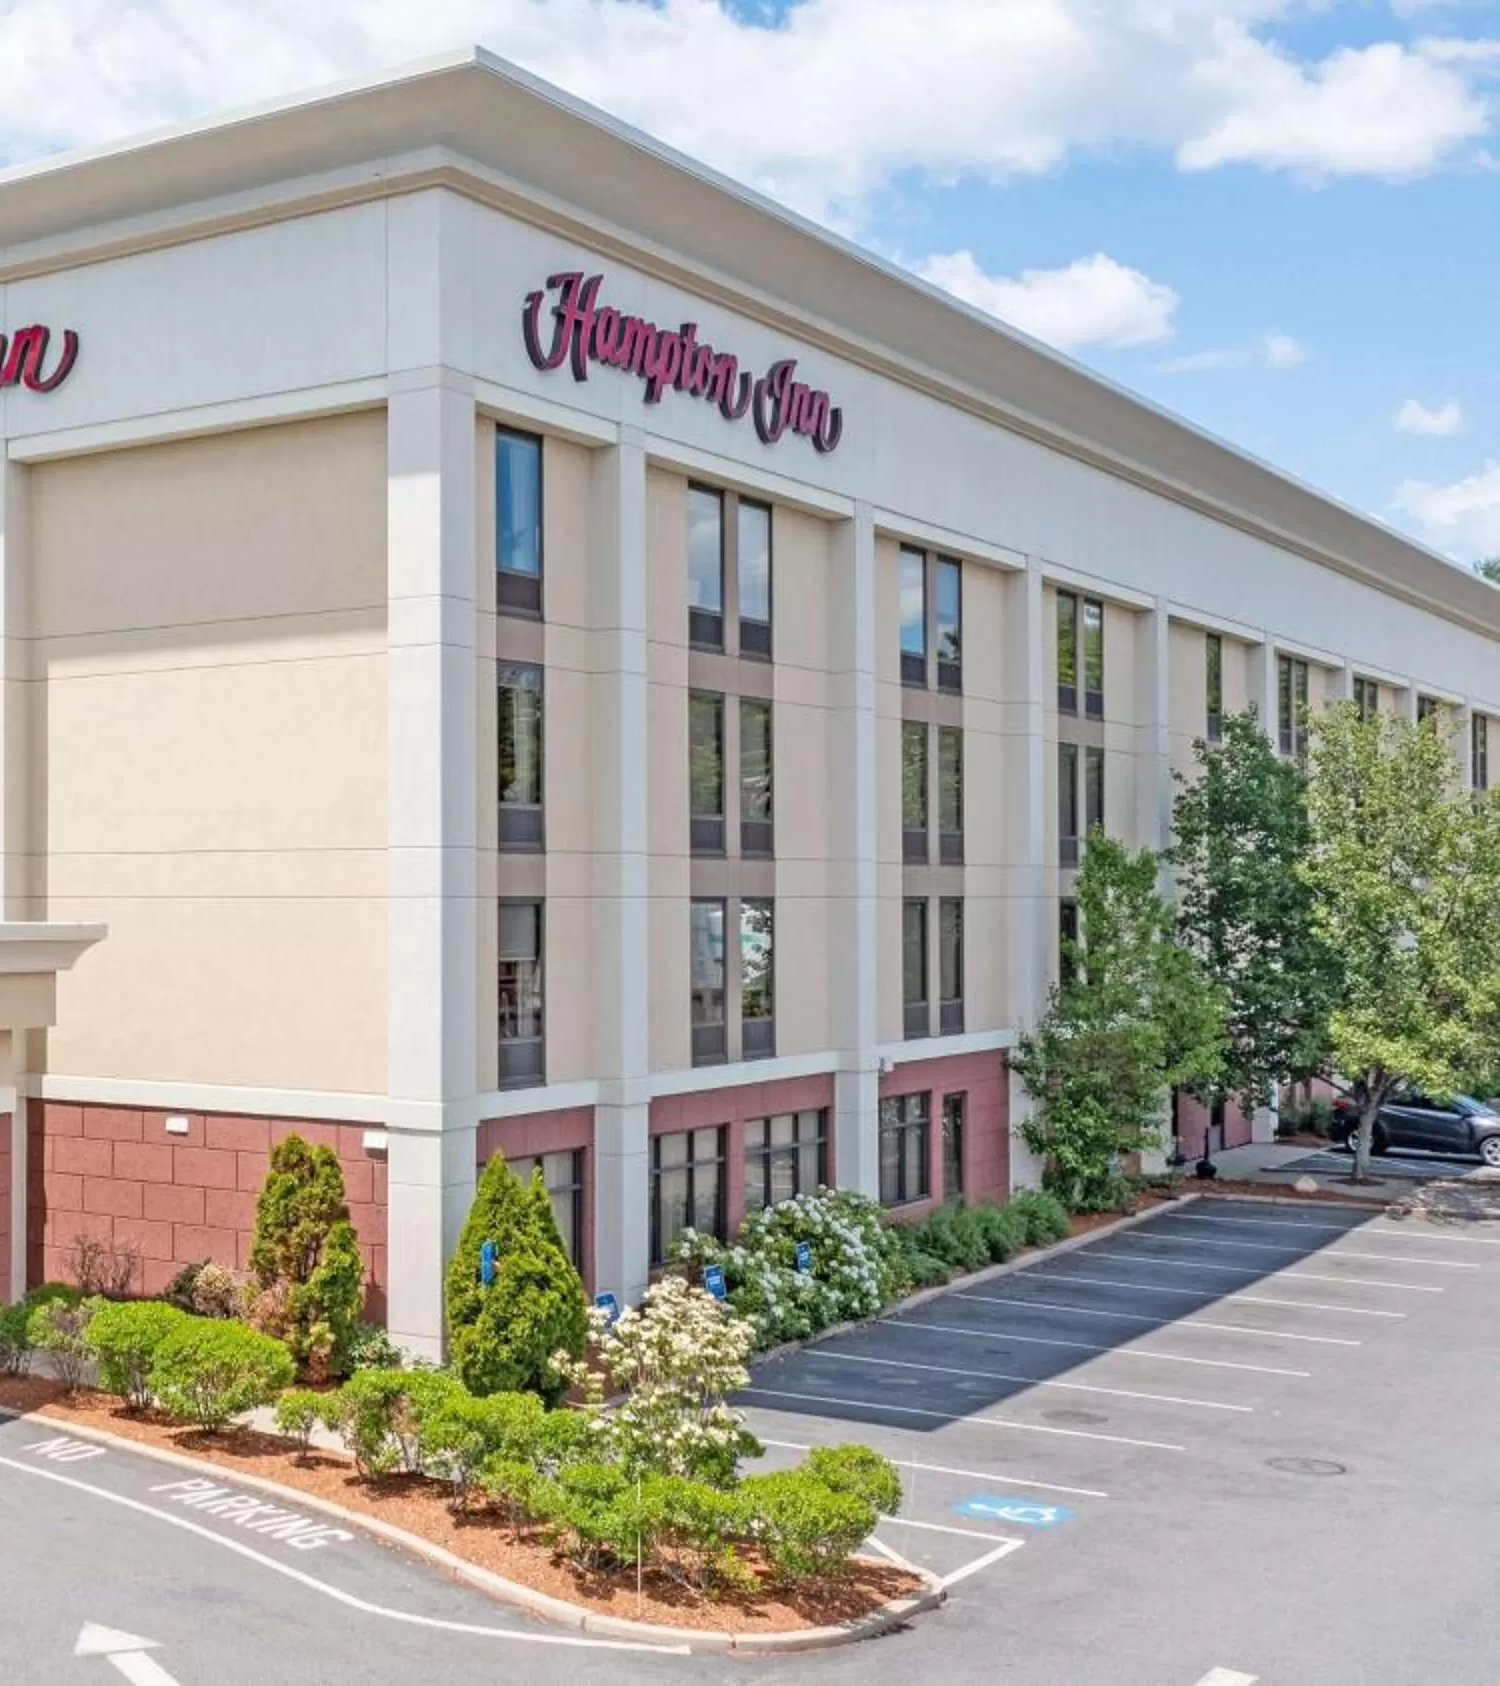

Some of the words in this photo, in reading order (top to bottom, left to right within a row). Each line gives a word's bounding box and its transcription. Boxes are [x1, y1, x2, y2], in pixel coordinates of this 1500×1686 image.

[523, 271, 753, 421] Hampton
[752, 359, 843, 454] Inn
[22, 1437, 107, 1462] NO
[148, 1477, 355, 1550] PARKING
